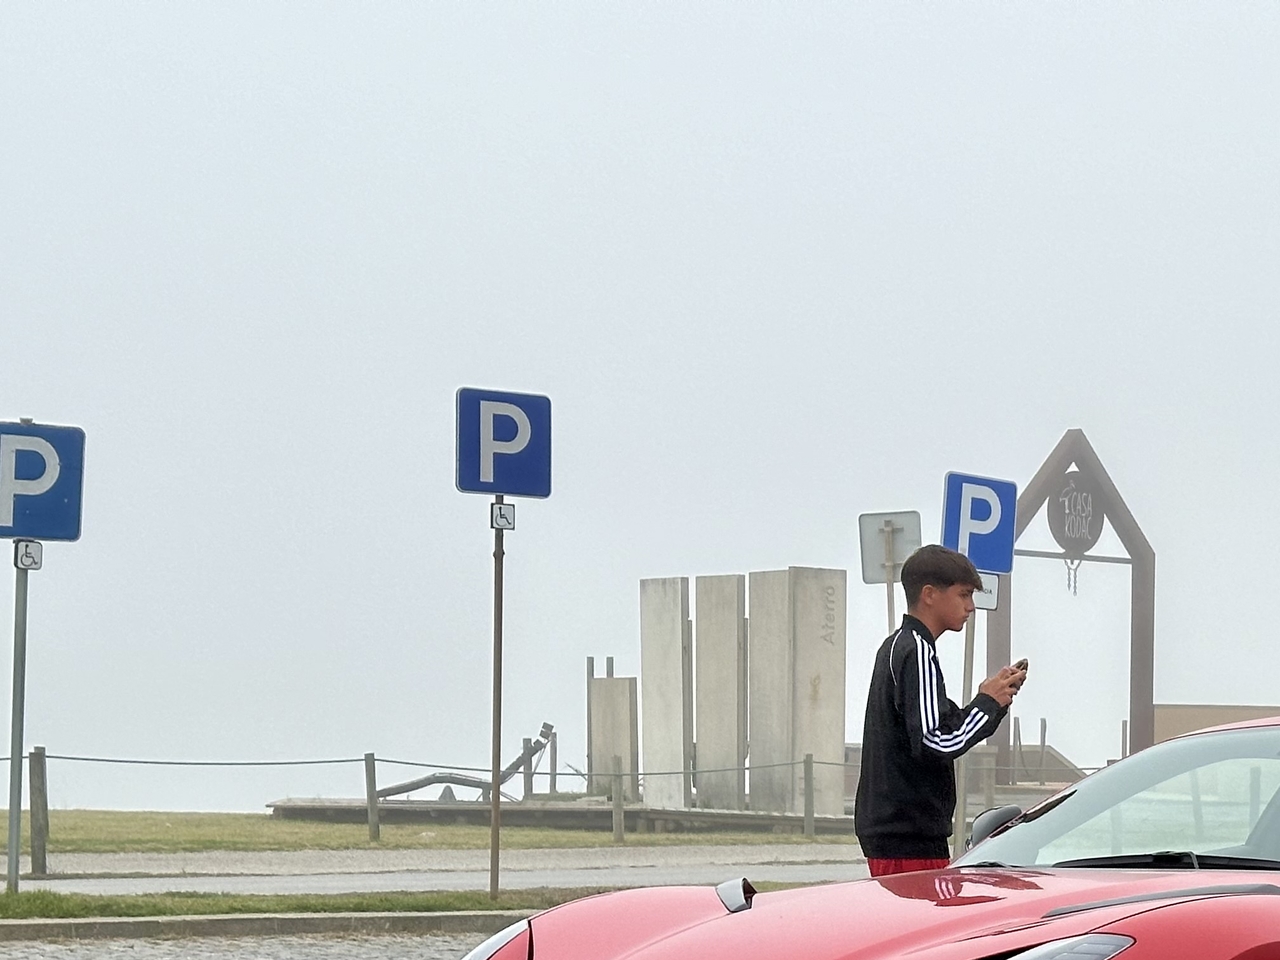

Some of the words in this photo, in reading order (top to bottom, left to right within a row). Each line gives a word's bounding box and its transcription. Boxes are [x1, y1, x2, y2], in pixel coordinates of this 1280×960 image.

[480, 400, 531, 483] P
[0, 434, 60, 527] P
[1071, 491, 1093, 517] CASA
[958, 482, 1002, 557] P
[820, 585, 836, 647] Aterro
